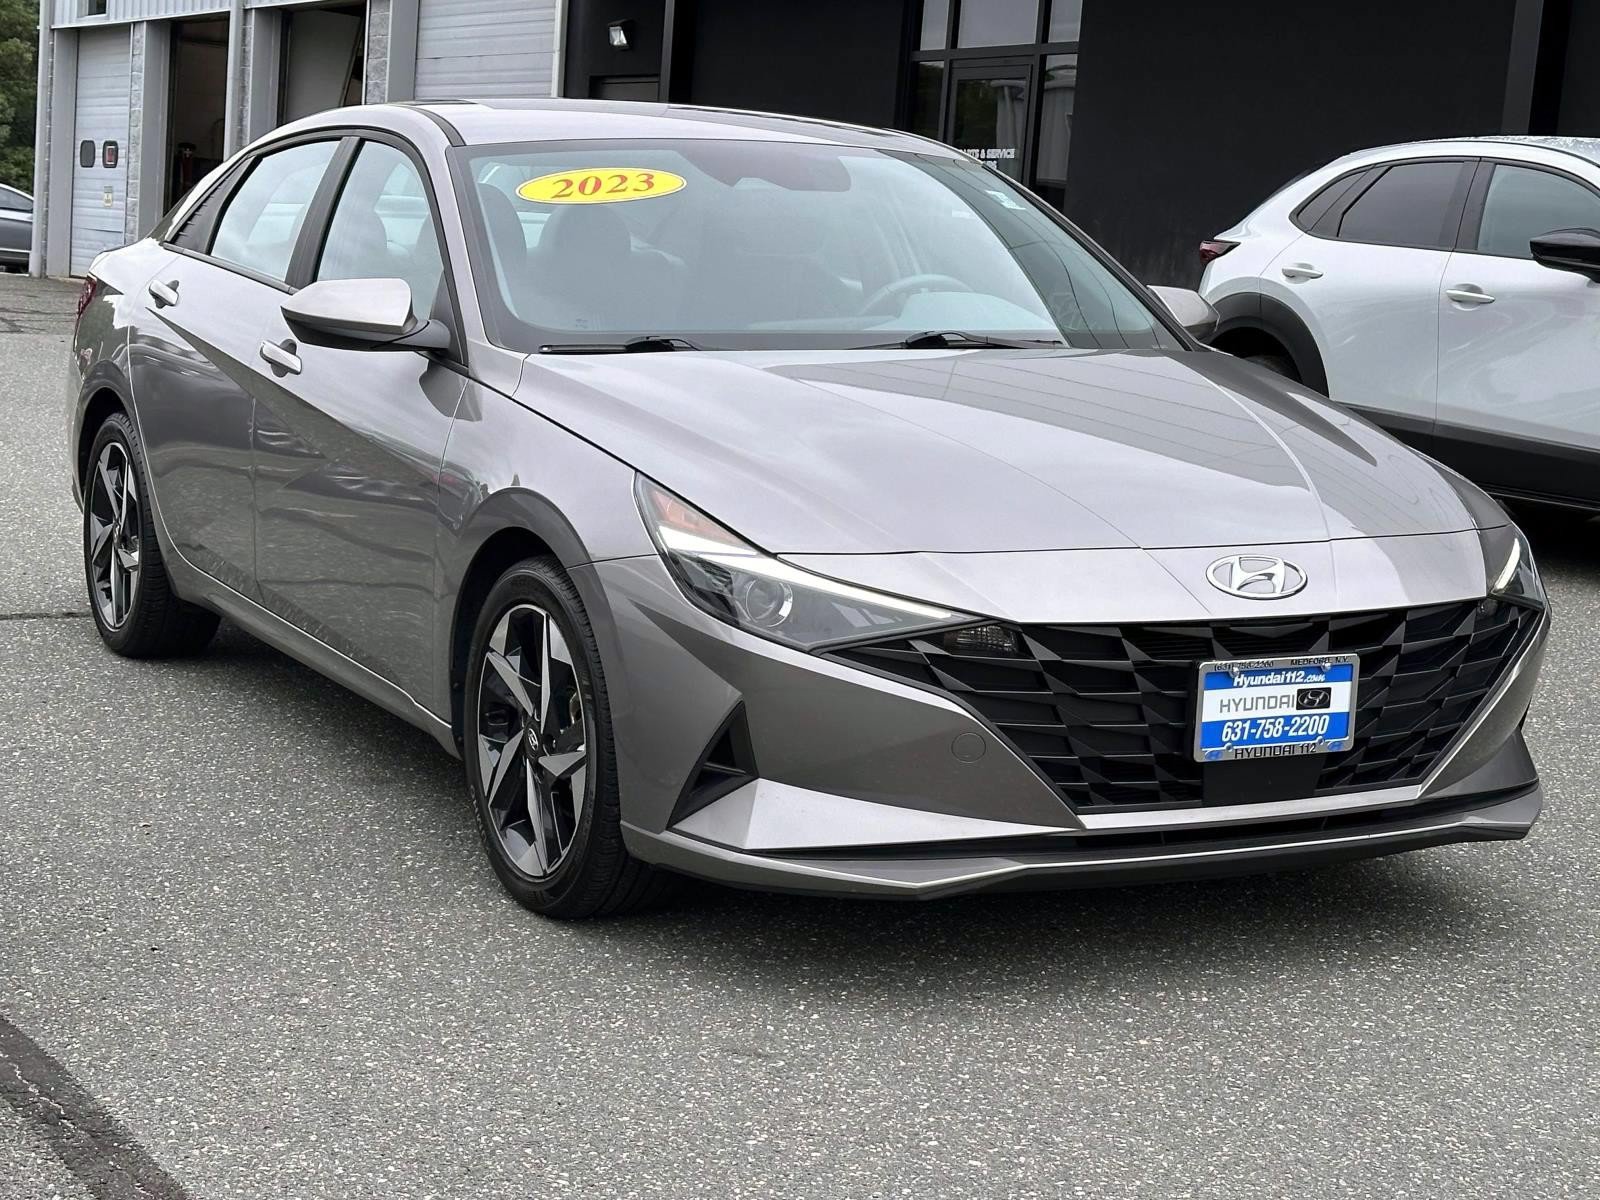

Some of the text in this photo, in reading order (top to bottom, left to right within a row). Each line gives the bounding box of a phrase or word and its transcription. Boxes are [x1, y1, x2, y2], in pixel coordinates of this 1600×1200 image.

[980, 149, 985, 158] &
[986, 149, 1014, 158] SERVICE
[551, 173, 655, 199] 2023
[1233, 671, 1325, 688] Hyundai112.com
[1219, 694, 1295, 713] HYUNDAI
[1222, 715, 1329, 742] 631-758-2200
[1234, 743, 1317, 759] HYUNDAI 112
